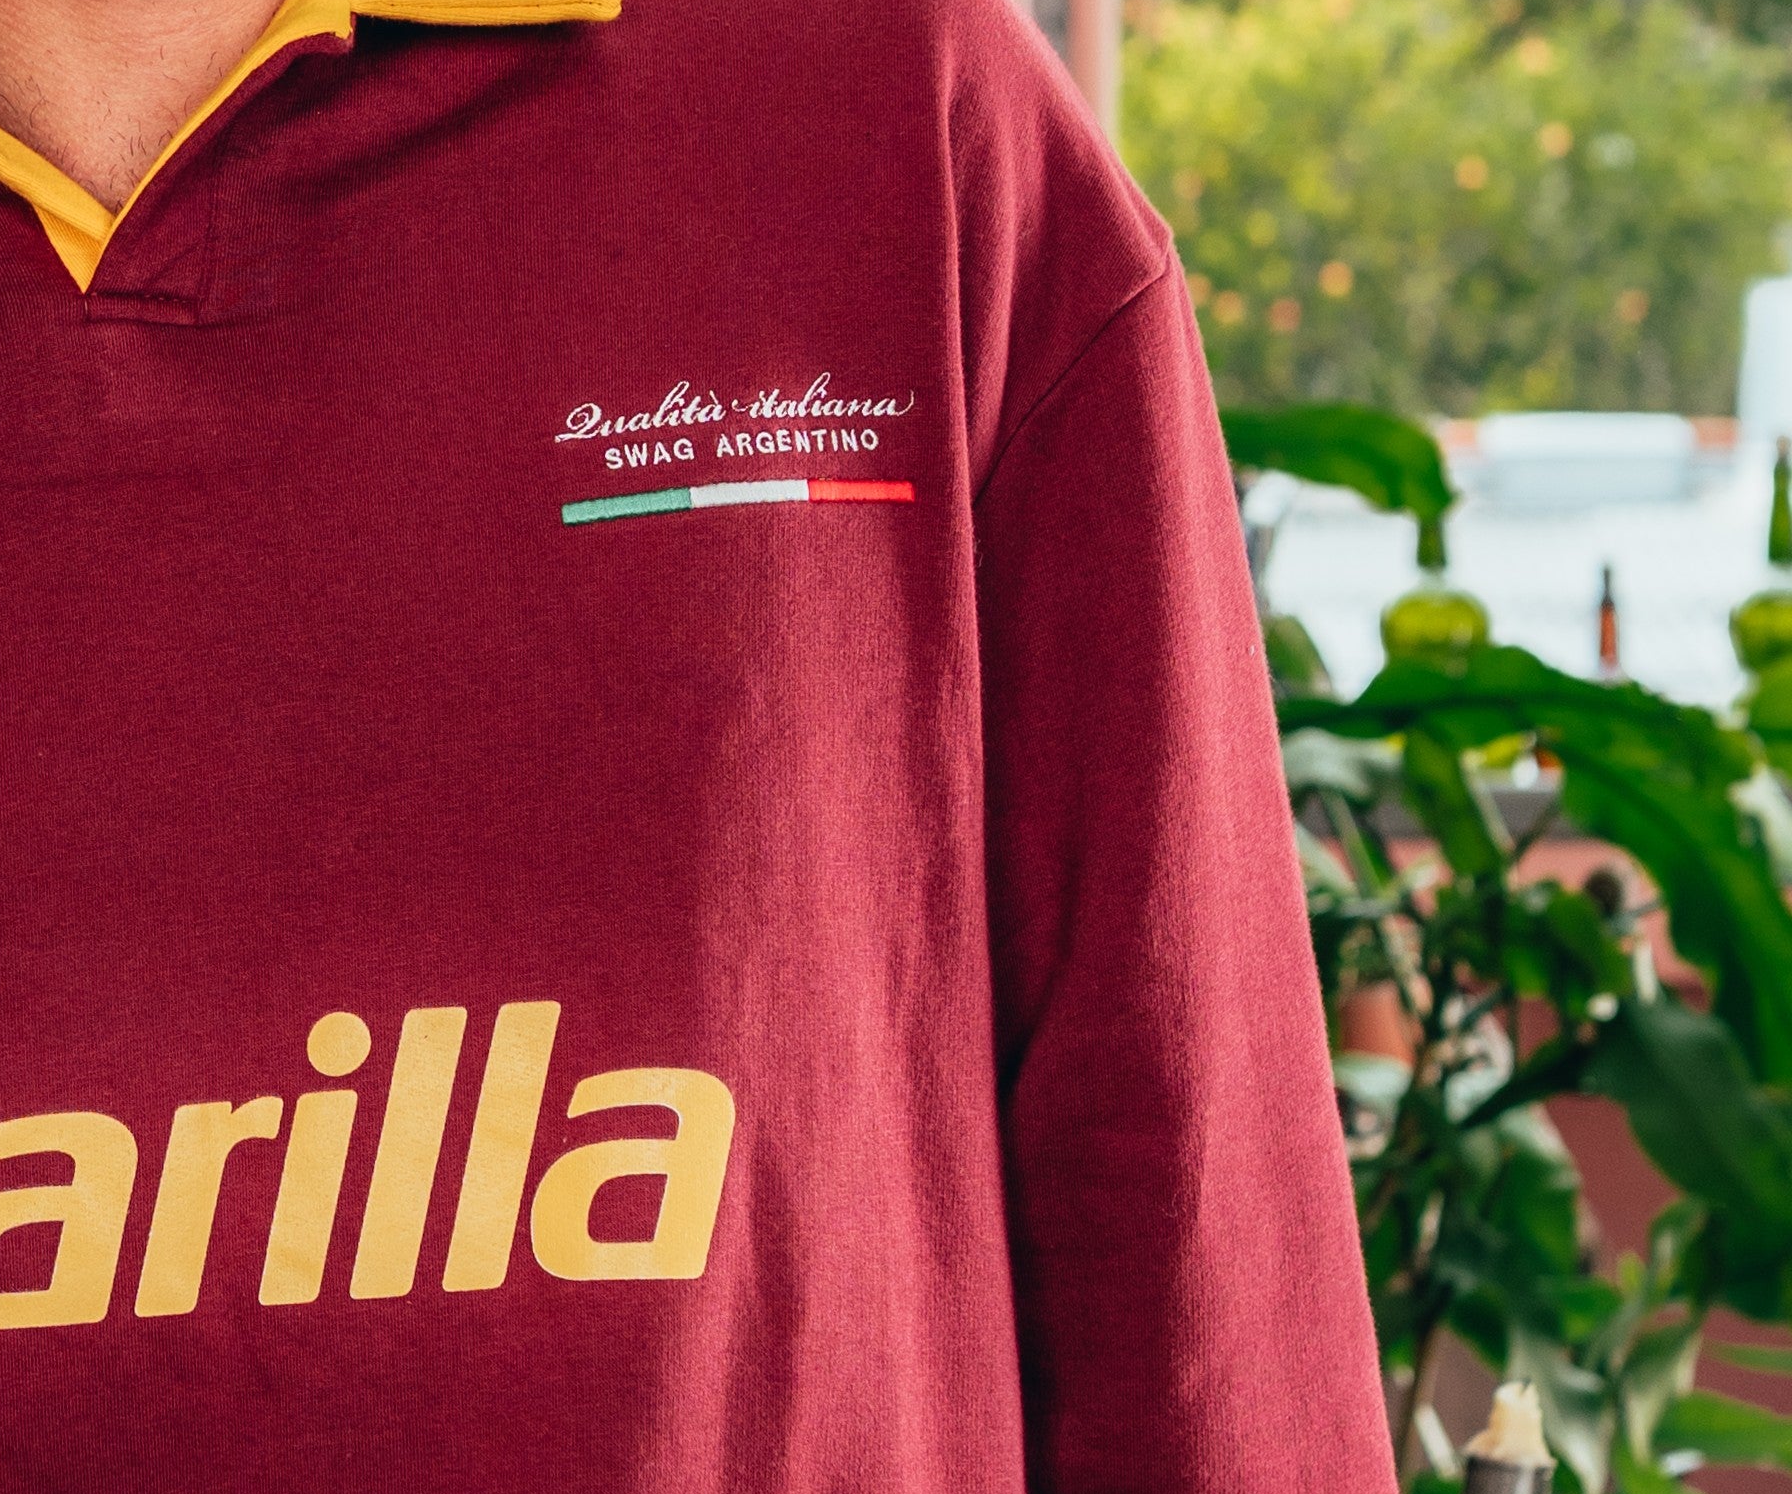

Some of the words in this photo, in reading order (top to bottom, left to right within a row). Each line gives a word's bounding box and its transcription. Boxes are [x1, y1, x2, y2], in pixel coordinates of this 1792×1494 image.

[554, 380, 728, 444] Qualità
[731, 371, 915, 420] italiana
[604, 438, 696, 471] SWAG
[716, 427, 880, 459] ARGENTINO
